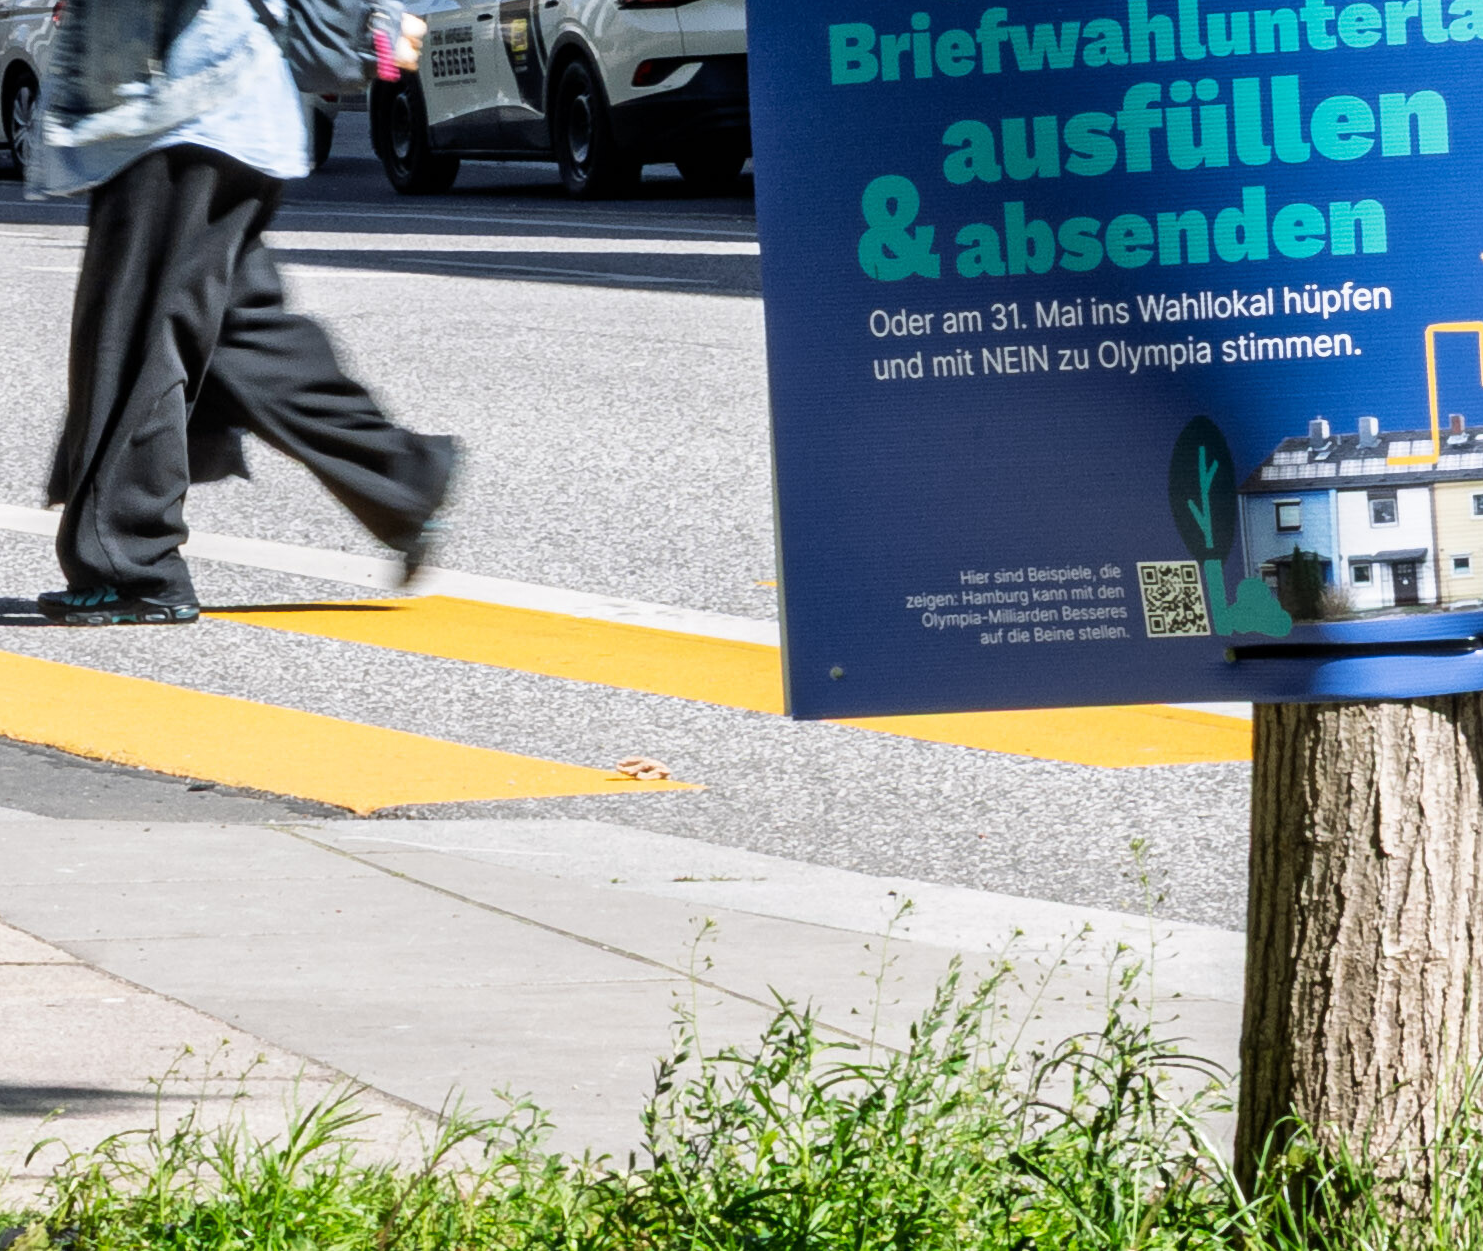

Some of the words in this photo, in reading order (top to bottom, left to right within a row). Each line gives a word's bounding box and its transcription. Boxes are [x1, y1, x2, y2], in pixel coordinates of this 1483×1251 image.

[942, 73, 1449, 187] ausfüllen
[857, 174, 941, 283] &
[955, 186, 1389, 280] absenden
[869, 307, 933, 338] Oder
[942, 309, 982, 334] am
[990, 302, 1027, 332] 31.
[1036, 298, 1083, 328] Mai
[1091, 294, 1129, 326] ins
[1136, 286, 1273, 322] Wahllokal
[1283, 281, 1392, 321] hüpfen
[873, 350, 923, 381] und
[932, 346, 973, 378] mit
[982, 343, 1049, 375] NEIN
[1057, 347, 1090, 372] zu
[1098, 336, 1212, 376] Olympia
[1221, 329, 1362, 362] stimmen.
[959, 569, 990, 586] Hier
[994, 567, 1024, 584] sind
[1027, 563, 1097, 585] Beispiele,
[1100, 562, 1122, 579] die
[905, 591, 960, 612] zeigen:
[962, 588, 1029, 607] Hamburg
[1031, 584, 1069, 601] kann
[1070, 584, 1094, 600] mit
[1097, 582, 1125, 599] den
[921, 605, 1059, 631] Olympia-Milliarden
[1061, 604, 1128, 622] Besseres
[980, 628, 1004, 645] auf
[1007, 626, 1031, 644] die
[1034, 624, 1075, 642] Beine
[1078, 622, 1131, 640] stellen.
